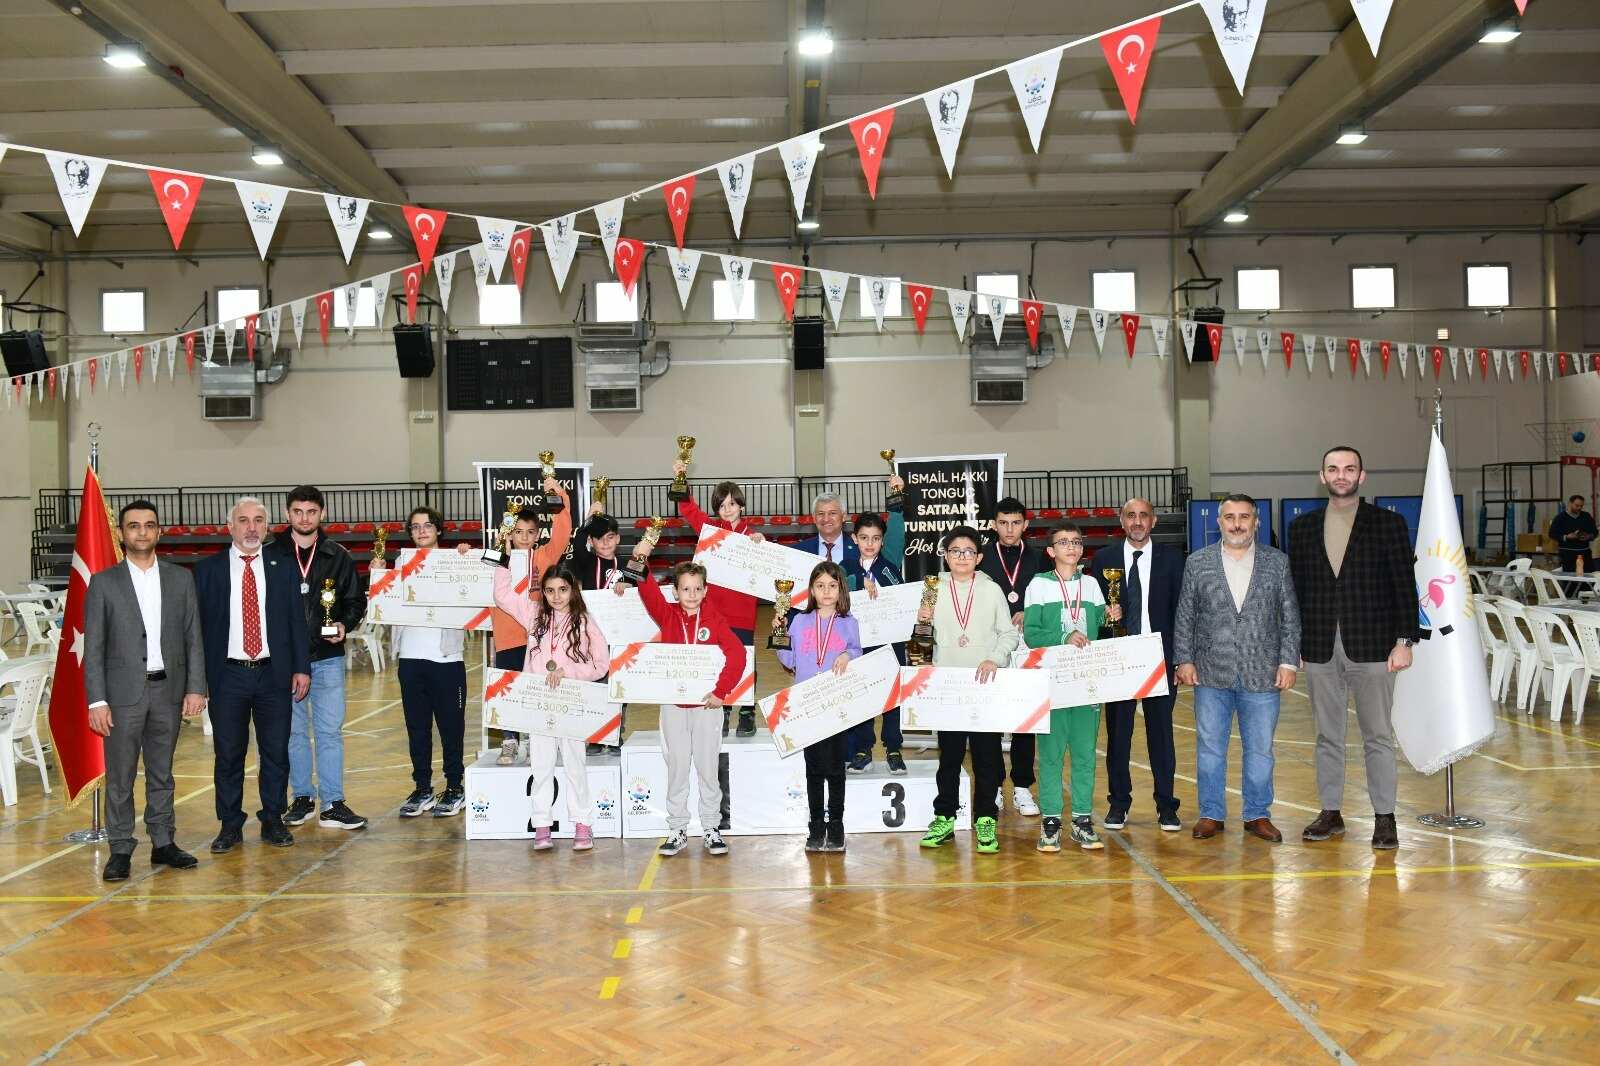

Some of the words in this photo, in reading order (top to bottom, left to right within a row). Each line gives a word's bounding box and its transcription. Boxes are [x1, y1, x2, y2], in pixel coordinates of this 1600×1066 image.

[492, 477, 535, 490] İSMAİL
[538, 480, 574, 490] HKKI
[908, 470, 949, 485] İSMAİL
[951, 471, 988, 483] HAKKI
[881, 782, 906, 828] 3
